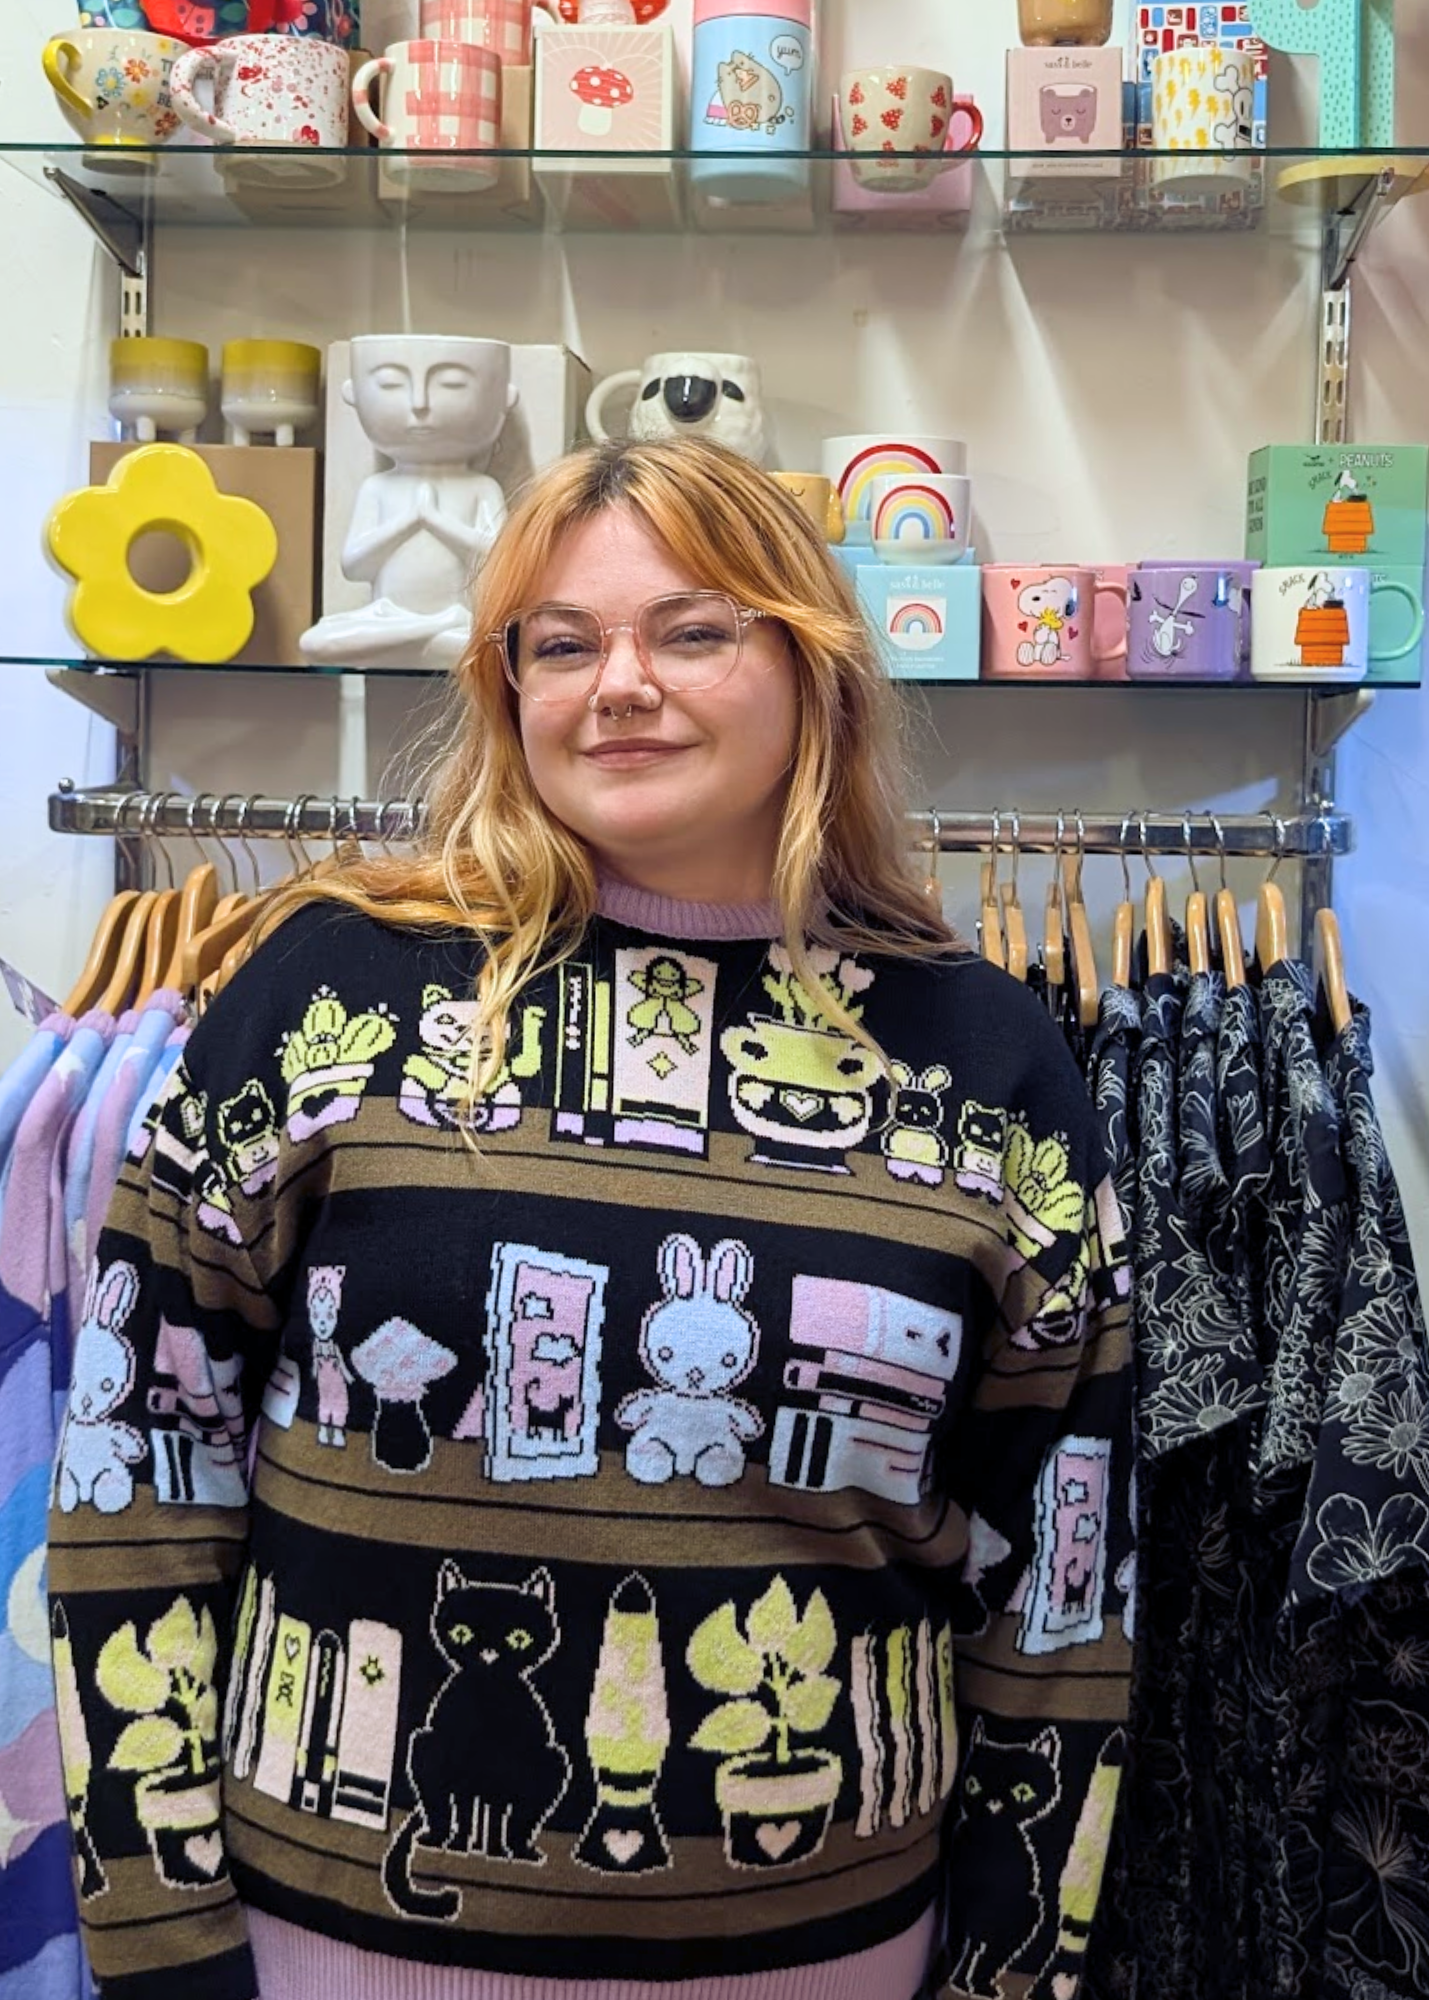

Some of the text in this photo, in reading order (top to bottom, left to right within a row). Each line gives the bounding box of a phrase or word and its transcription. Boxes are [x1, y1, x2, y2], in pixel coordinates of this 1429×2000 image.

[1072, 60, 1092, 69] belle
[1339, 453, 1393, 468] PEANUTS
[1279, 573, 1305, 596] SMACK
